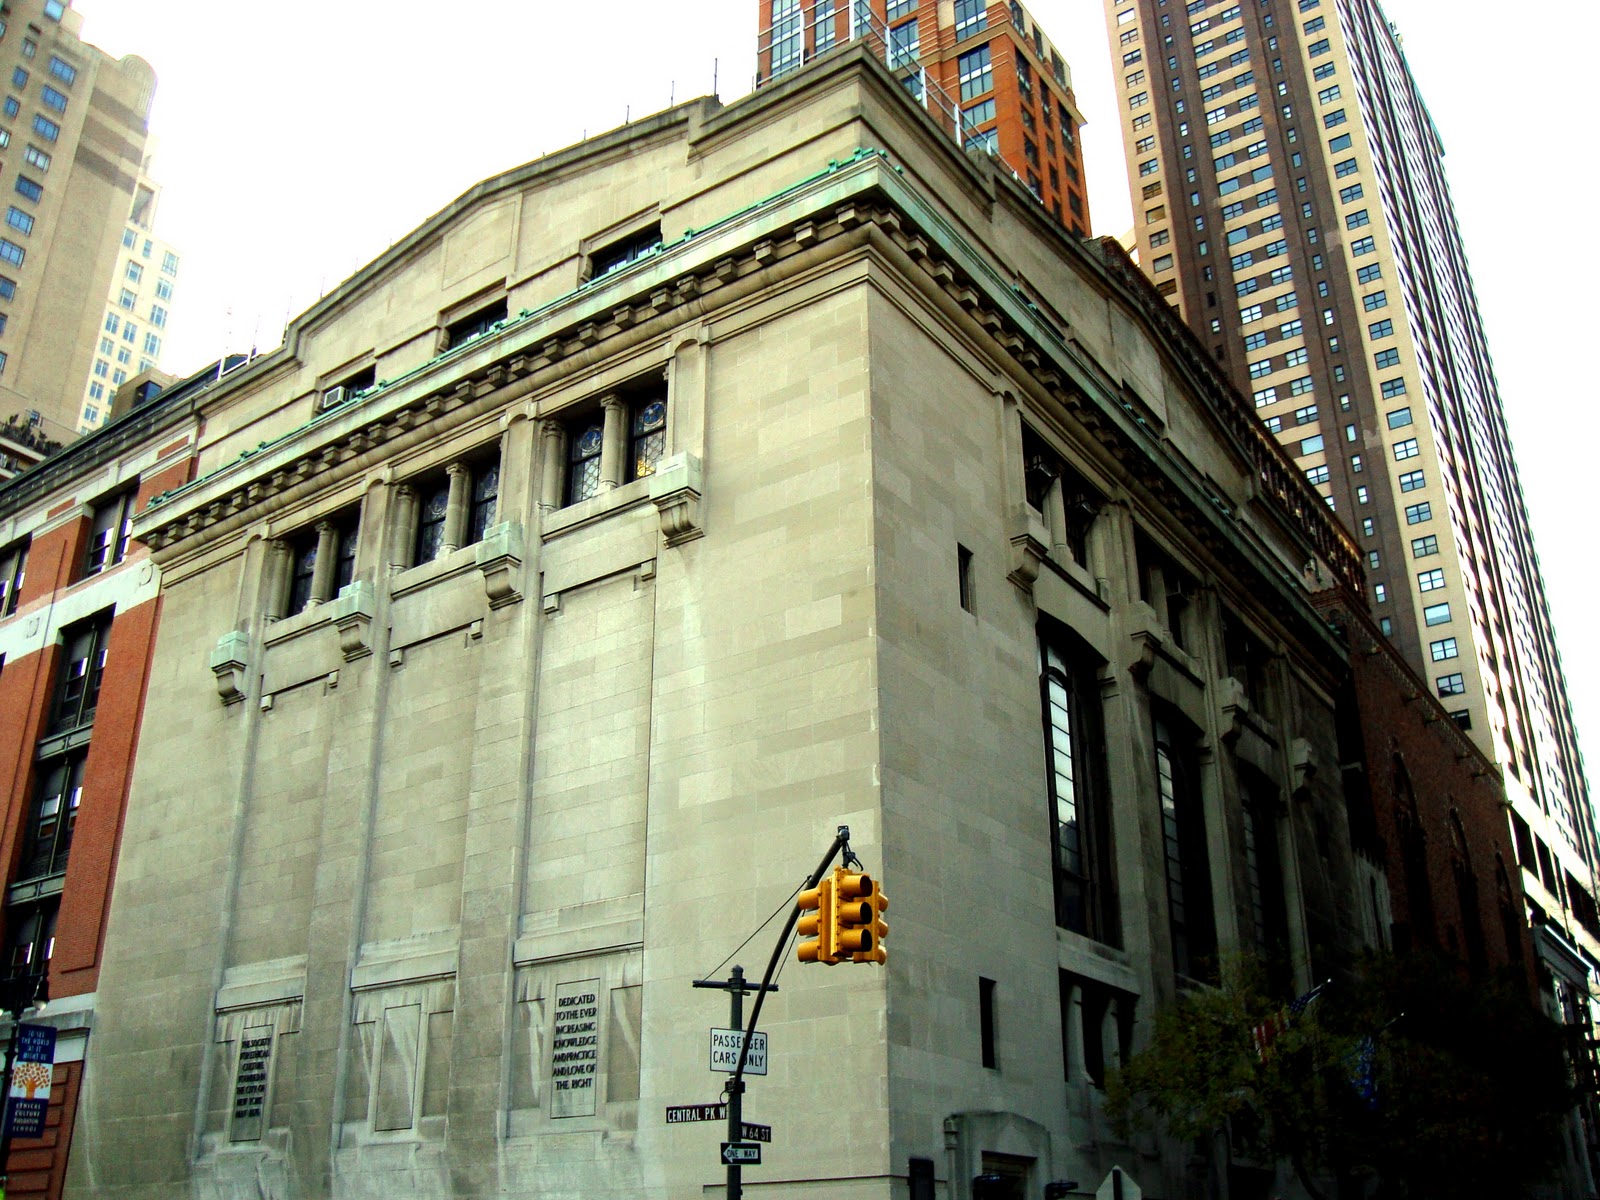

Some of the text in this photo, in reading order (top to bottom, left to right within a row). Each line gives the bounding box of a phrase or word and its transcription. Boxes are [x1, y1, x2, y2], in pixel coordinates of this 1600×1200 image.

[558, 994, 595, 1007] DEDICATED
[556, 1007, 597, 1021] TO THE EVER
[556, 1022, 596, 1036] INCREASING
[553, 1036, 597, 1050] KNOWLEDGE
[553, 1050, 596, 1063] AND PRACTICE
[713, 1051, 737, 1065] CARS
[553, 1064, 597, 1077] AND LOVE OF
[556, 1078, 593, 1091] THE RIGHT
[667, 1106, 726, 1123] CENTRAL PK W
[741, 1126, 770, 1141] W 64 ST
[727, 1149, 756, 1159] ONE WAY
